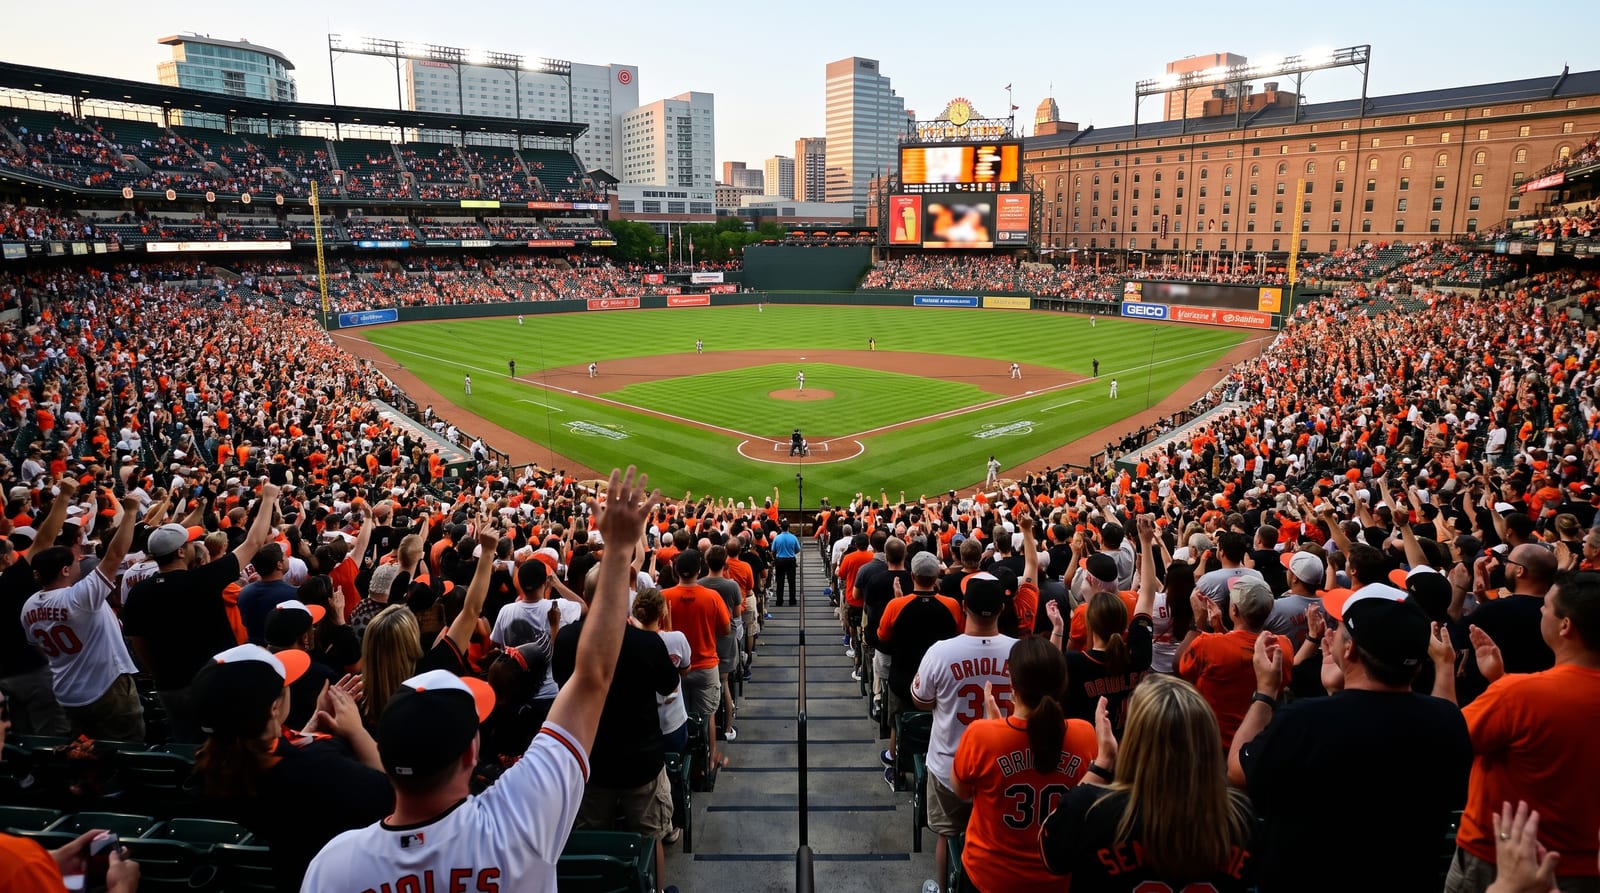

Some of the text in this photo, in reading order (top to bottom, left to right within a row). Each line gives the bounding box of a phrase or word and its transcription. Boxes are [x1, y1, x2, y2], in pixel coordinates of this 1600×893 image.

[1127, 304, 1164, 317] GEICO
[33, 625, 83, 657] 30
[950, 657, 1009, 681] ORIOLE
[957, 684, 1015, 726] 35
[997, 748, 1082, 778] BRIER
